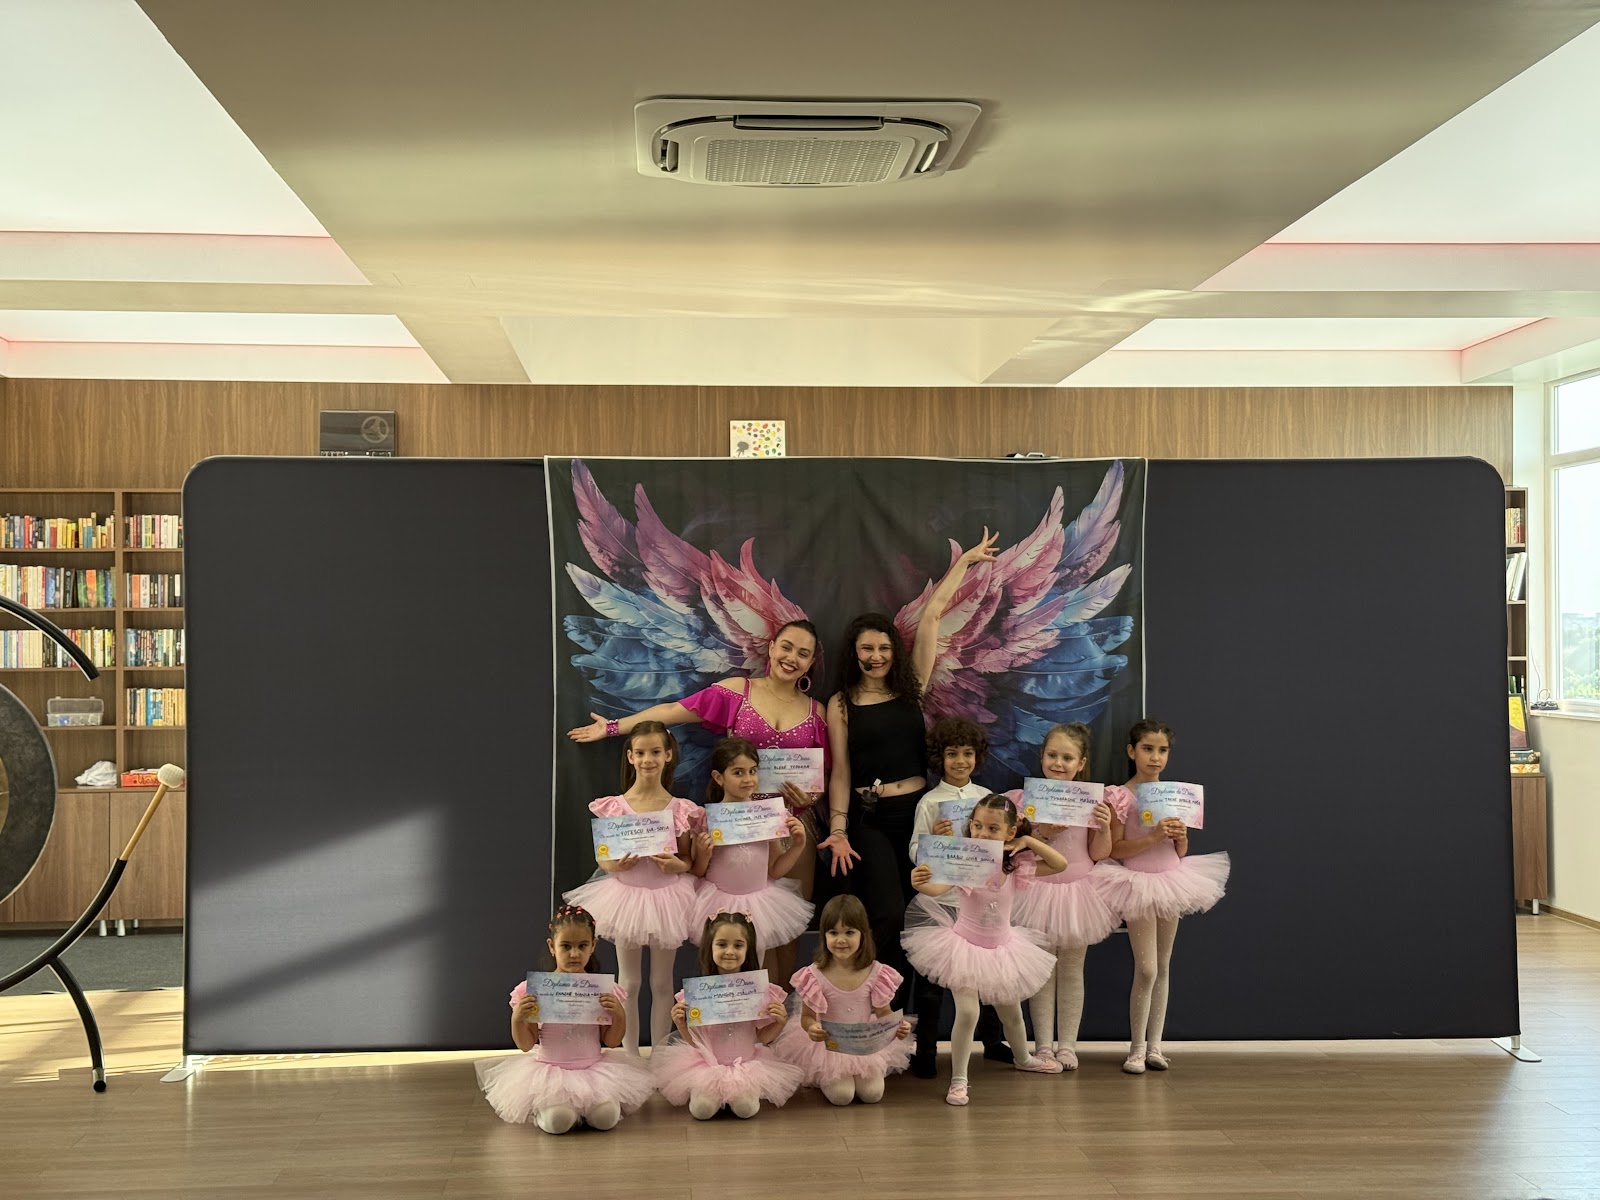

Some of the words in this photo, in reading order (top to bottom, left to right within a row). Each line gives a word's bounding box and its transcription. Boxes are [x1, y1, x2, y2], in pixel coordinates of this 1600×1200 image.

[760, 754, 784, 763] Diploma
[1038, 784, 1064, 794] Diploma
[1150, 787, 1175, 796] Diploma
[721, 807, 745, 816] Diploma
[952, 805, 974, 813] Diplom
[608, 821, 633, 830] Diploma
[933, 841, 960, 852] Diploma
[542, 978, 570, 989] Diploma
[580, 980, 599, 988] Dans
[699, 983, 726, 992] Diploma
[736, 979, 754, 987] Dans
